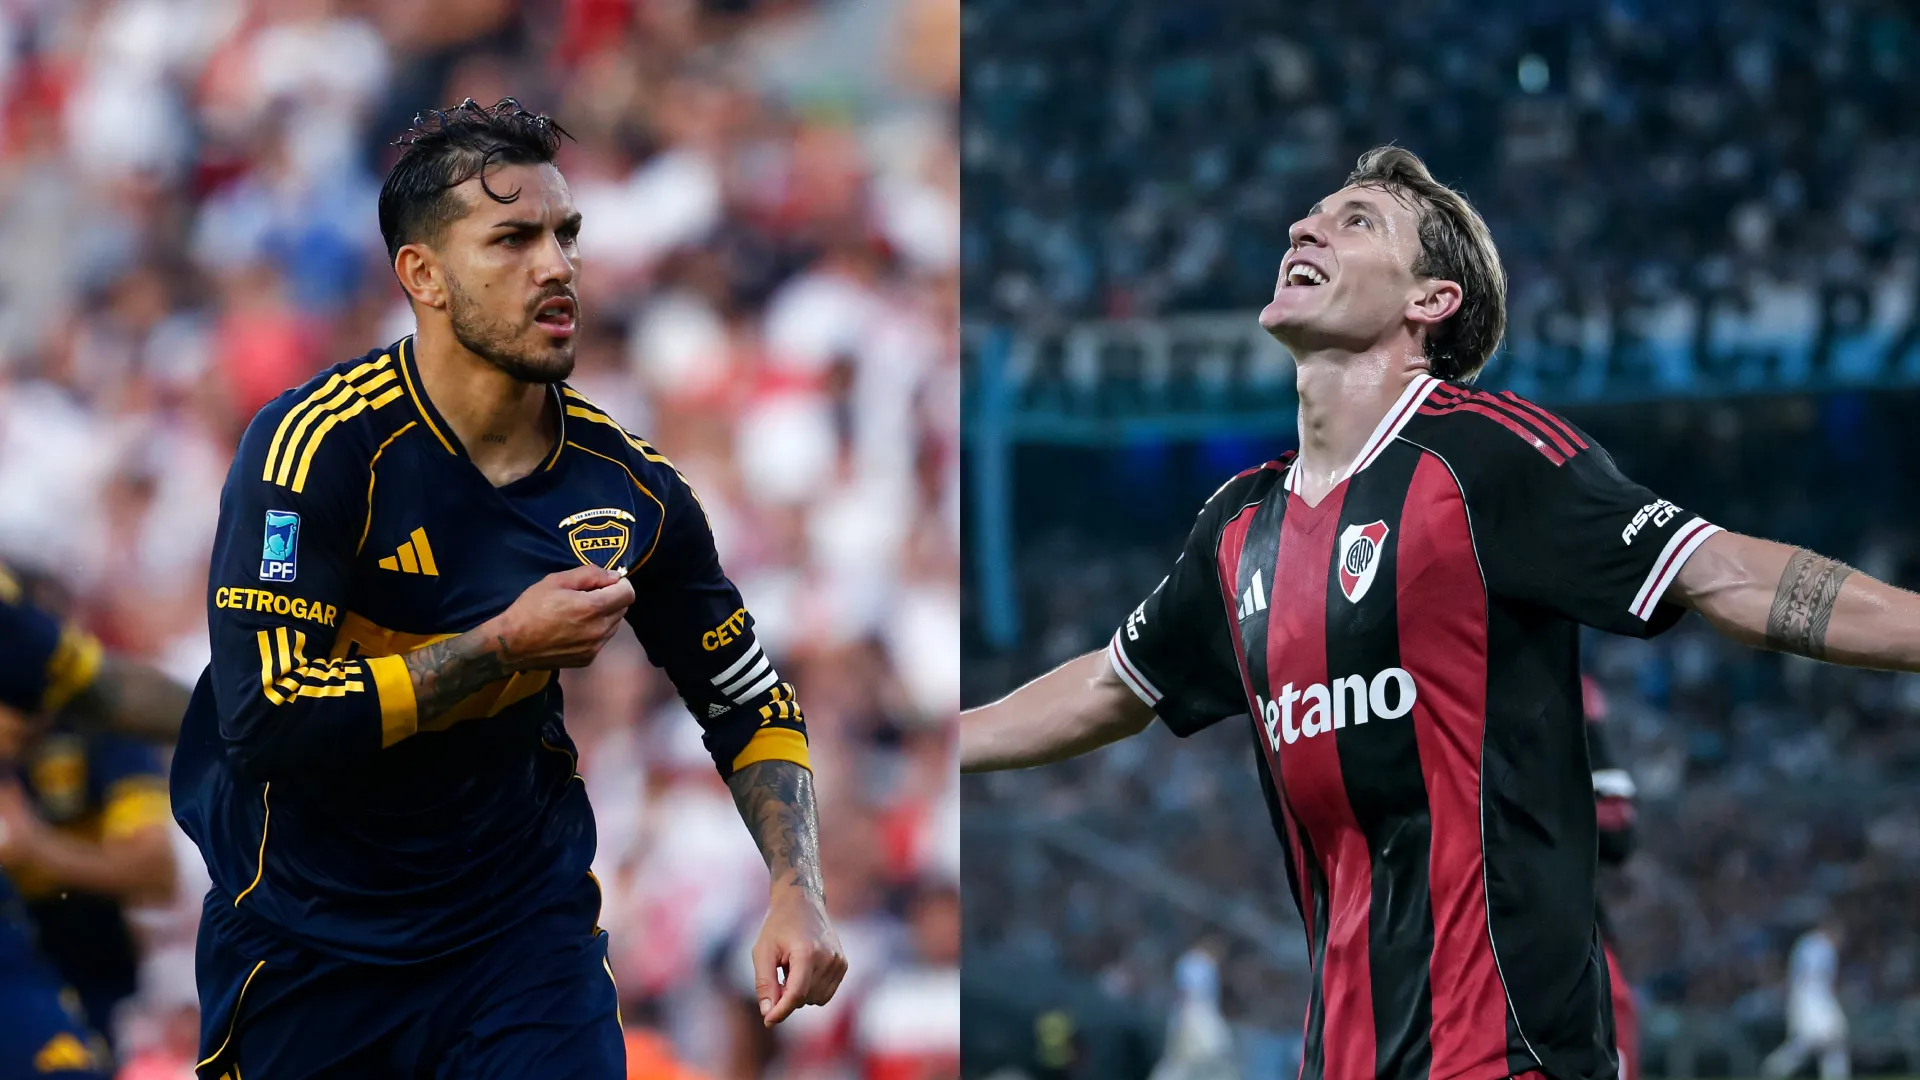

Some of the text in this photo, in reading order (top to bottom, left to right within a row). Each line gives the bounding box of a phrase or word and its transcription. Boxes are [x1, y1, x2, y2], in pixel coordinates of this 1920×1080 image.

[584, 510, 618, 518] ANIVERSARIO
[580, 538, 620, 549] CABJ
[261, 561, 294, 579] LPF
[215, 586, 338, 628] CETROGAR
